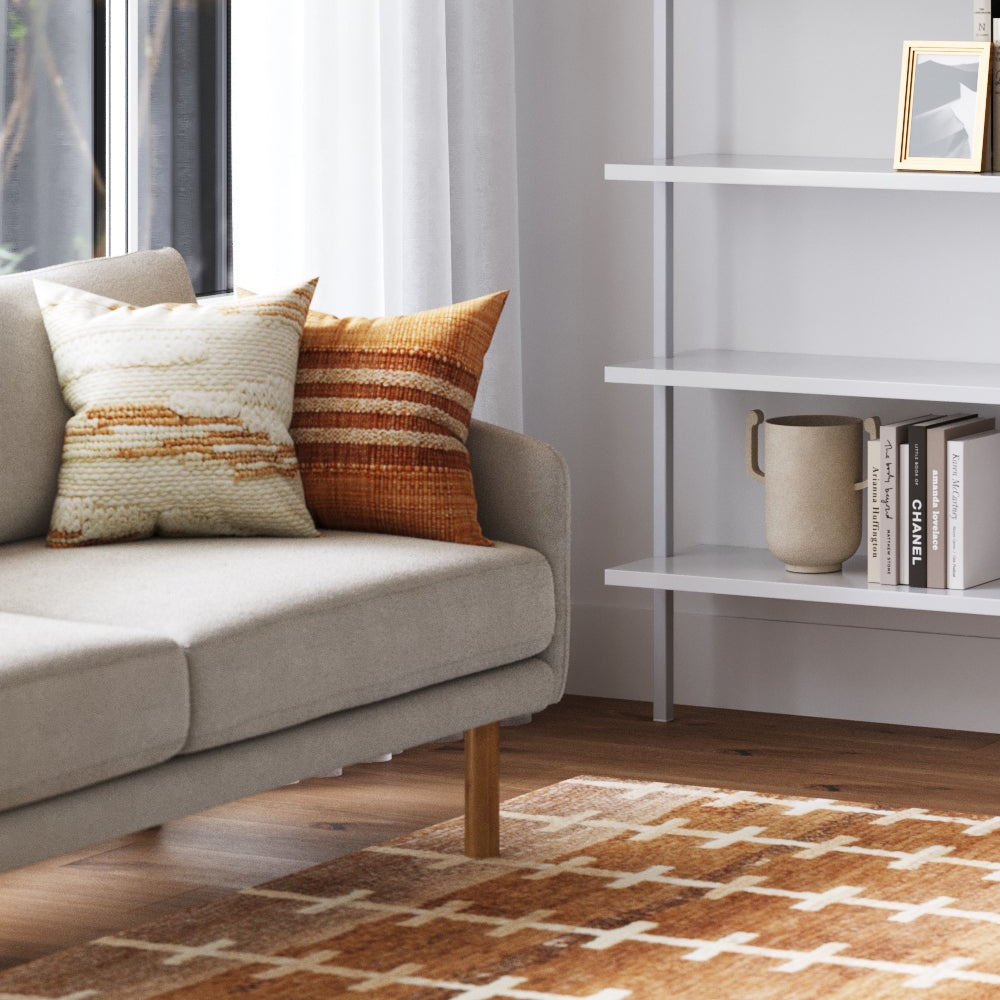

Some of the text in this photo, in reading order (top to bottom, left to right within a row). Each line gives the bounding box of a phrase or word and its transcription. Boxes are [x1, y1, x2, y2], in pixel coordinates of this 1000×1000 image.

[871, 466, 880, 558] Arianna Huffington
[911, 499, 923, 566] CHANEL
